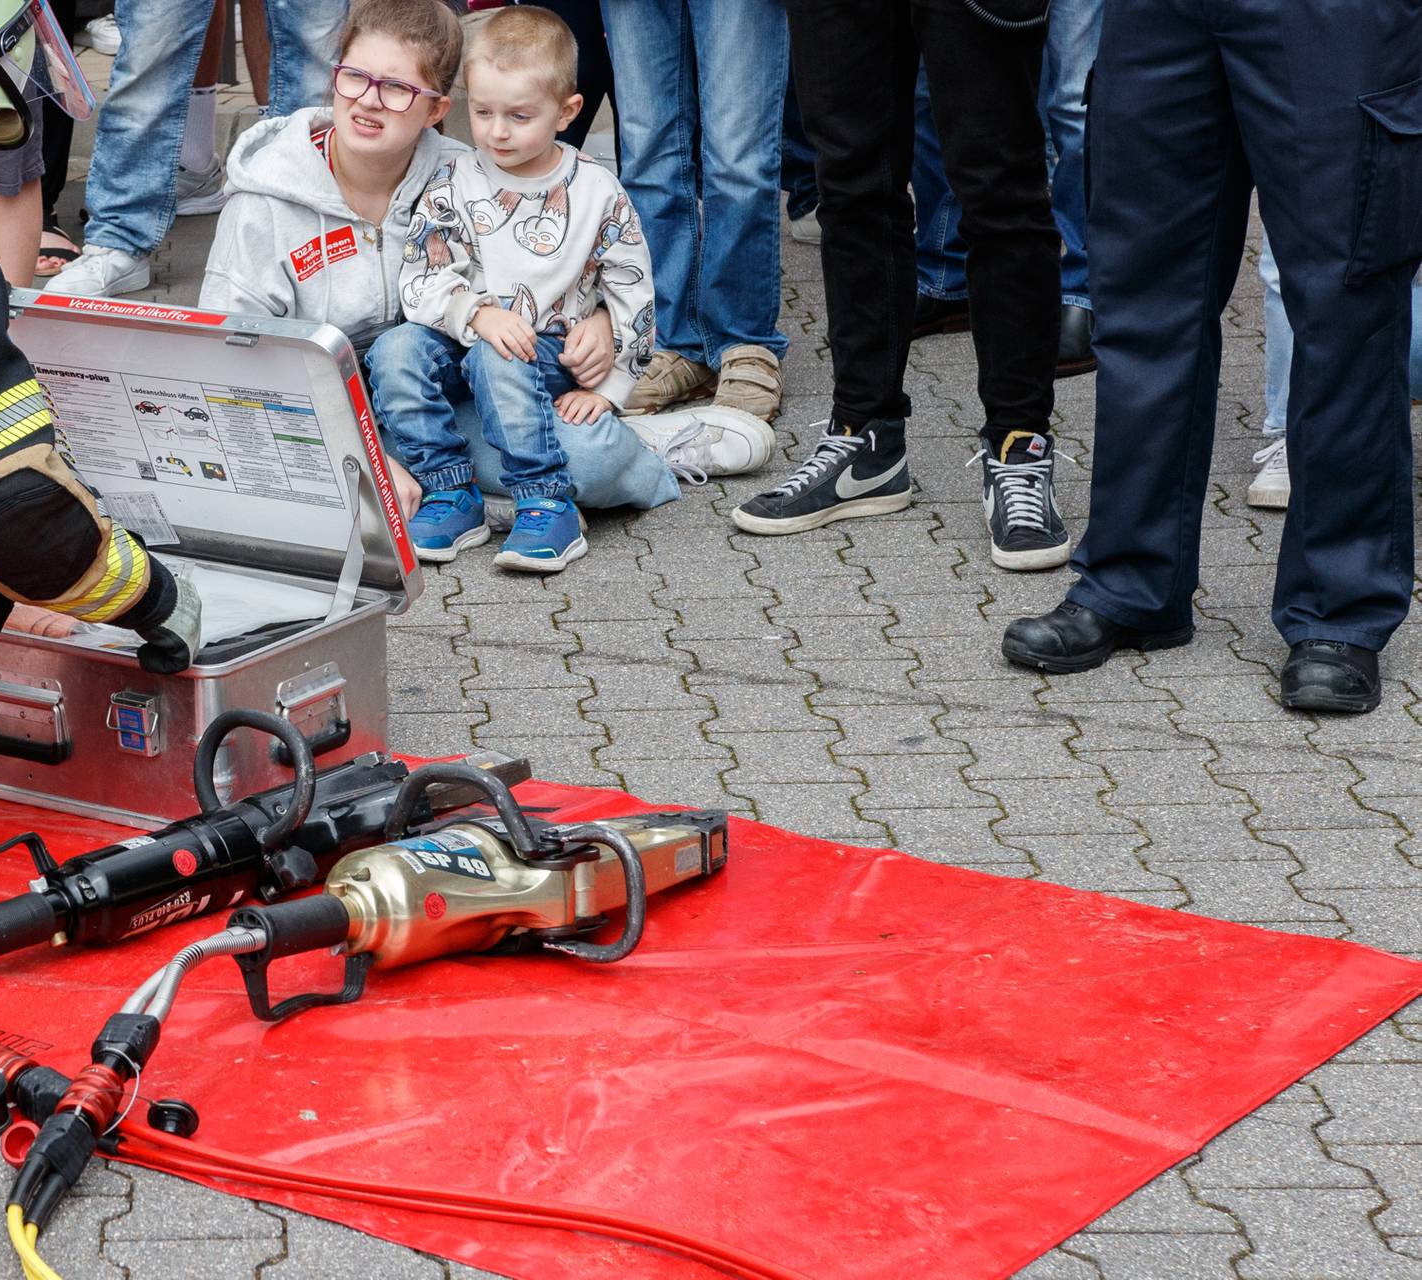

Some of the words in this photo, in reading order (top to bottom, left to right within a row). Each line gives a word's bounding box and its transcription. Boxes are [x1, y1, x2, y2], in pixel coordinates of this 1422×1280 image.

[326, 238, 351, 250] ssen
[69, 298, 192, 322] Verkehrsunfallkoffer
[359, 409, 403, 540] Verkehrsunfallkoffer
[416, 851, 452, 868] SP
[457, 855, 491, 877] 49
